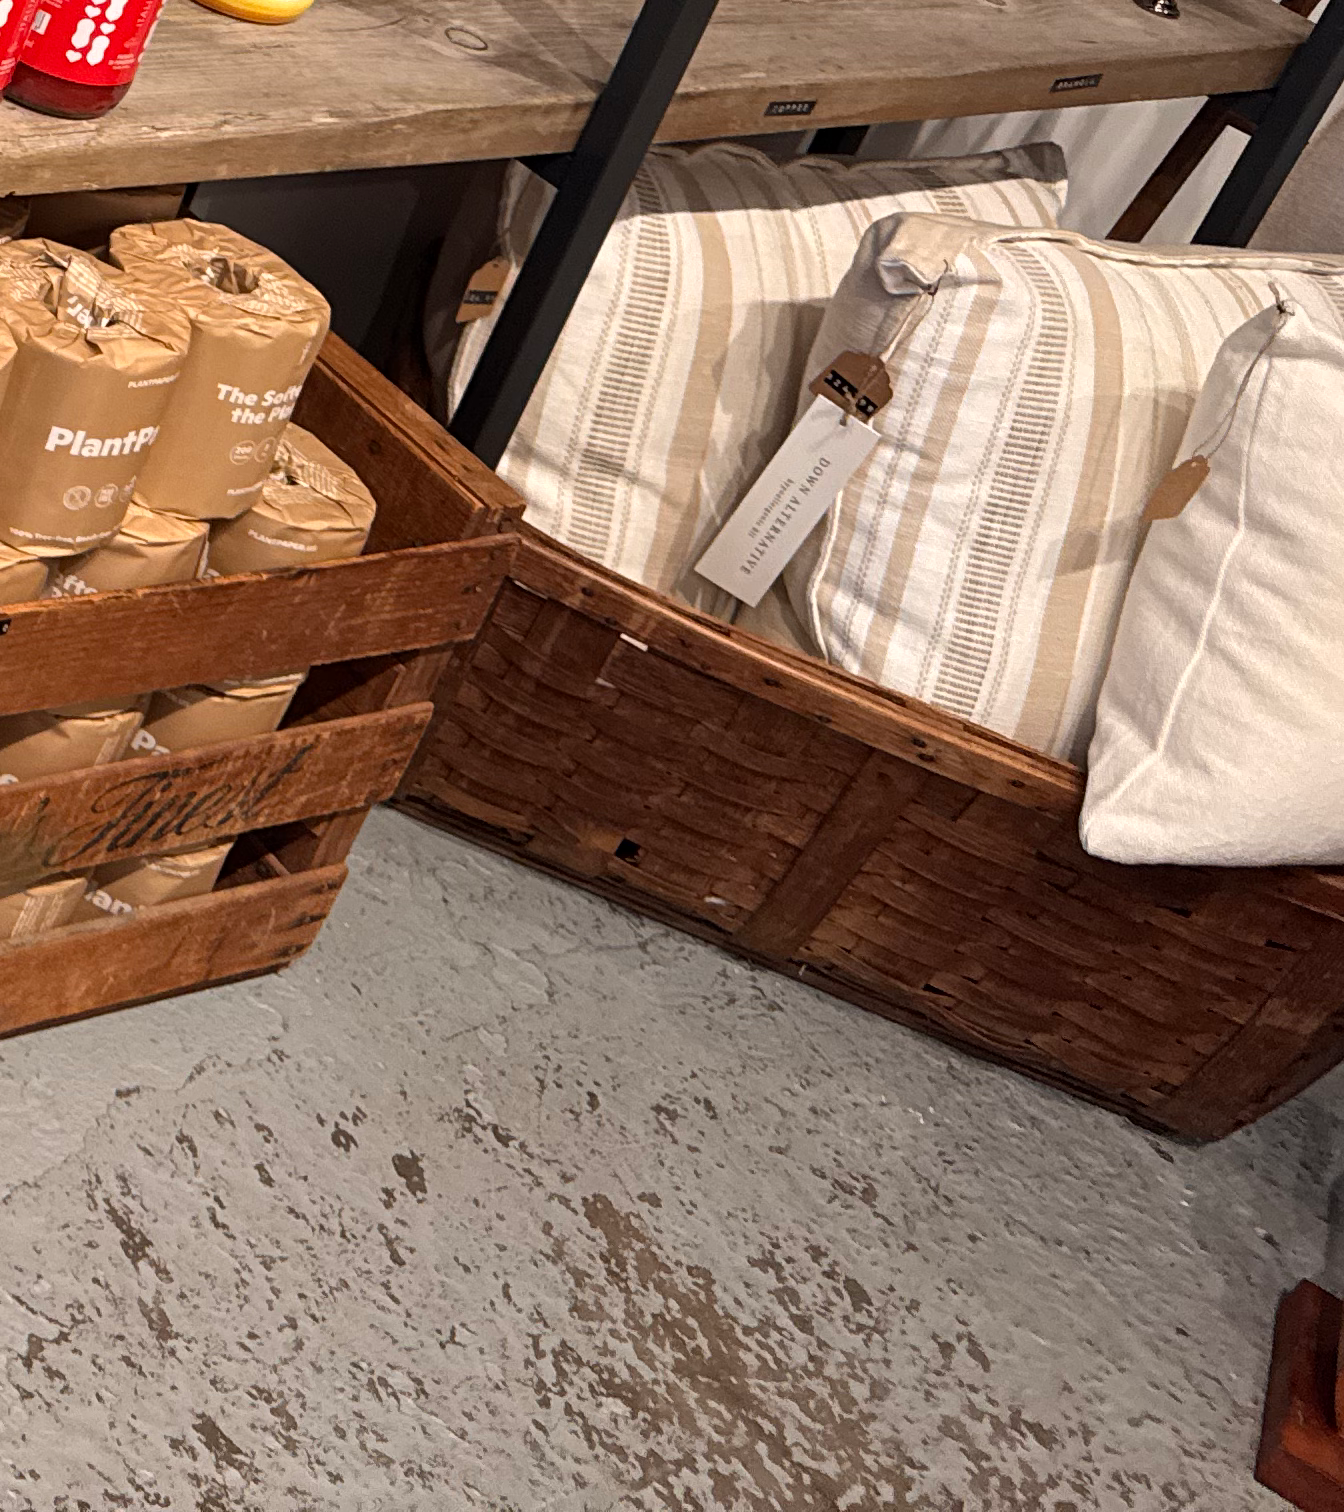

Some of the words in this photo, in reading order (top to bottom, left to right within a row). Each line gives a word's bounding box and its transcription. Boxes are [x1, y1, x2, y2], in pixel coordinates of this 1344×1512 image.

[217, 383, 258, 406] The
[231, 408, 265, 424] the
[799, 458, 831, 496] DOWN
[740, 496, 801, 574] ALTERNATIVE
